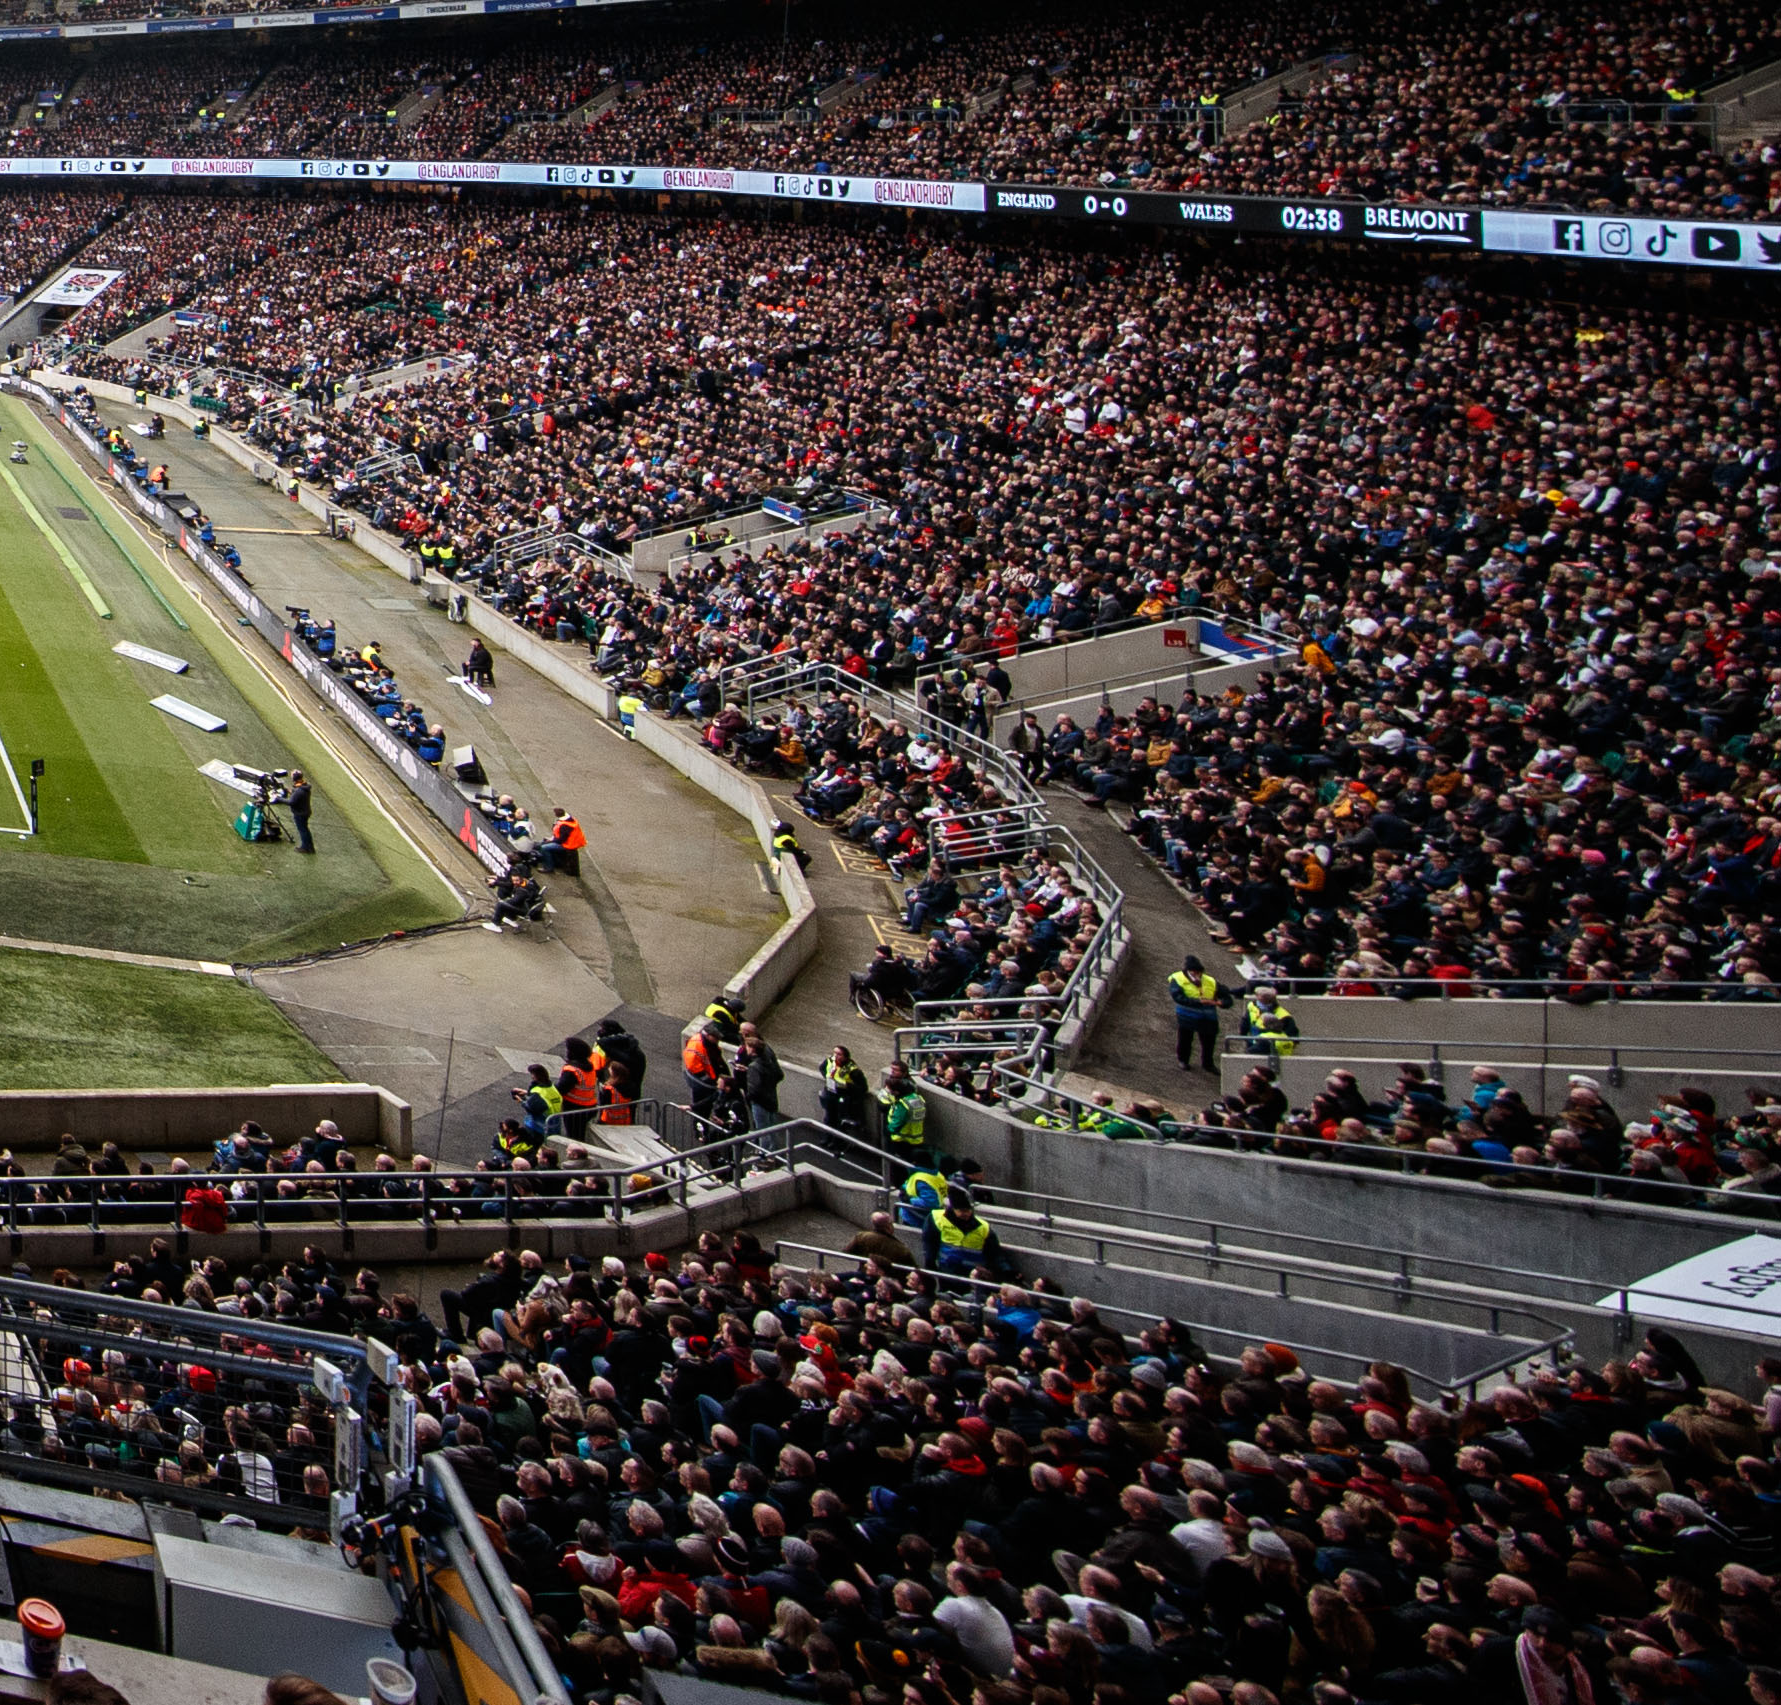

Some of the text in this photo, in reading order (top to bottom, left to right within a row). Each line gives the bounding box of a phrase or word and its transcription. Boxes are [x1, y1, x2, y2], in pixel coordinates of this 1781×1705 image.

[172, 159, 254, 175] @ENGLANDRUGBY
[418, 162, 501, 181] @ENGLANDRUGBY
[663, 169, 735, 190] @ENGLANDRUGBY
[874, 180, 955, 206] @ENGLANDRUGBY
[997, 191, 1057, 209] ENGLAND
[1180, 202, 1234, 221] WALES
[1281, 206, 1343, 231] 02:38
[1365, 207, 1470, 231] BREMONT
[320, 672, 399, 764] IT'S WEATHERPROOF
